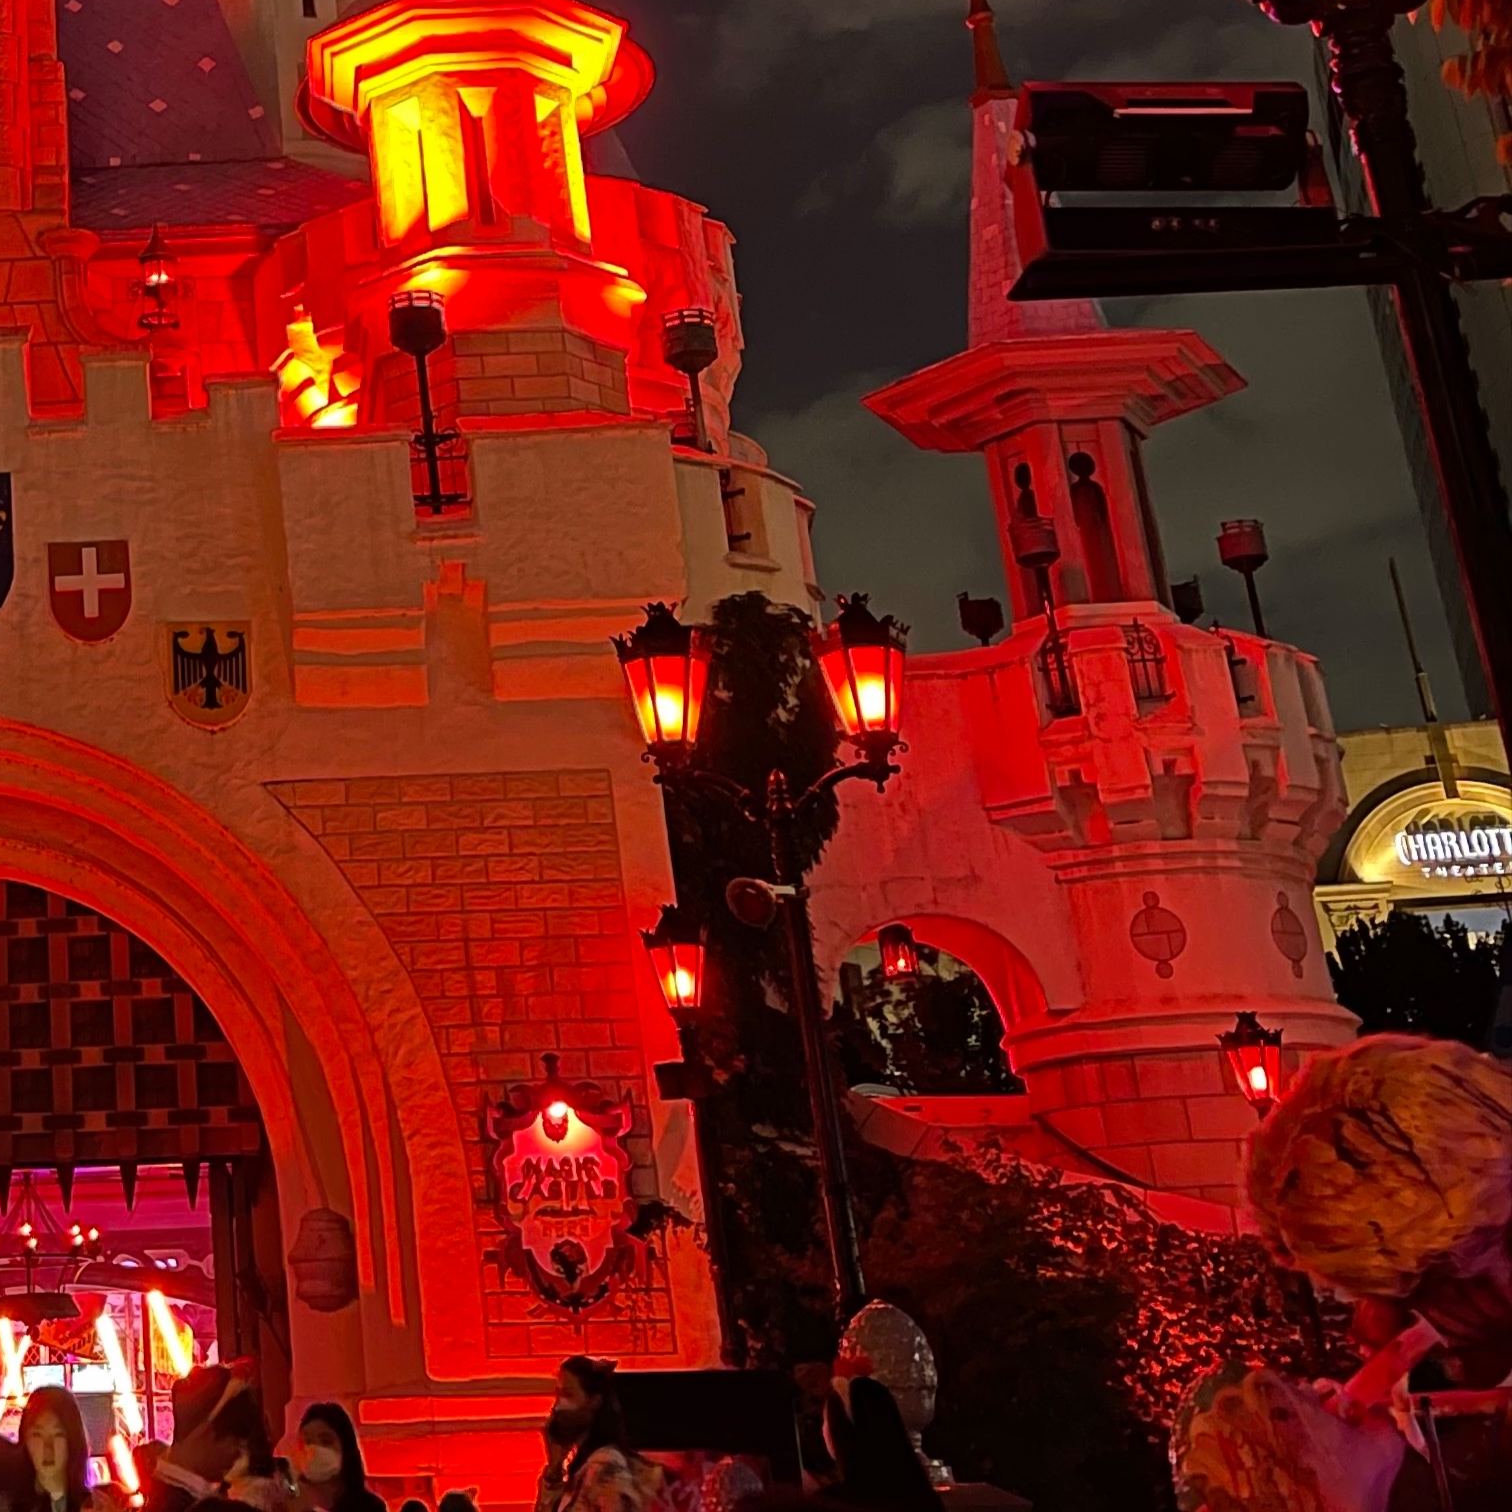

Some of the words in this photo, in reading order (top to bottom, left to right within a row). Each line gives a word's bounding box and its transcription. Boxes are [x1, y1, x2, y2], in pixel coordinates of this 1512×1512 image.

[1421, 861, 1512, 879] THEATE
[521, 1156, 600, 1182] MAGIC
[509, 1179, 619, 1204] CASTLE
